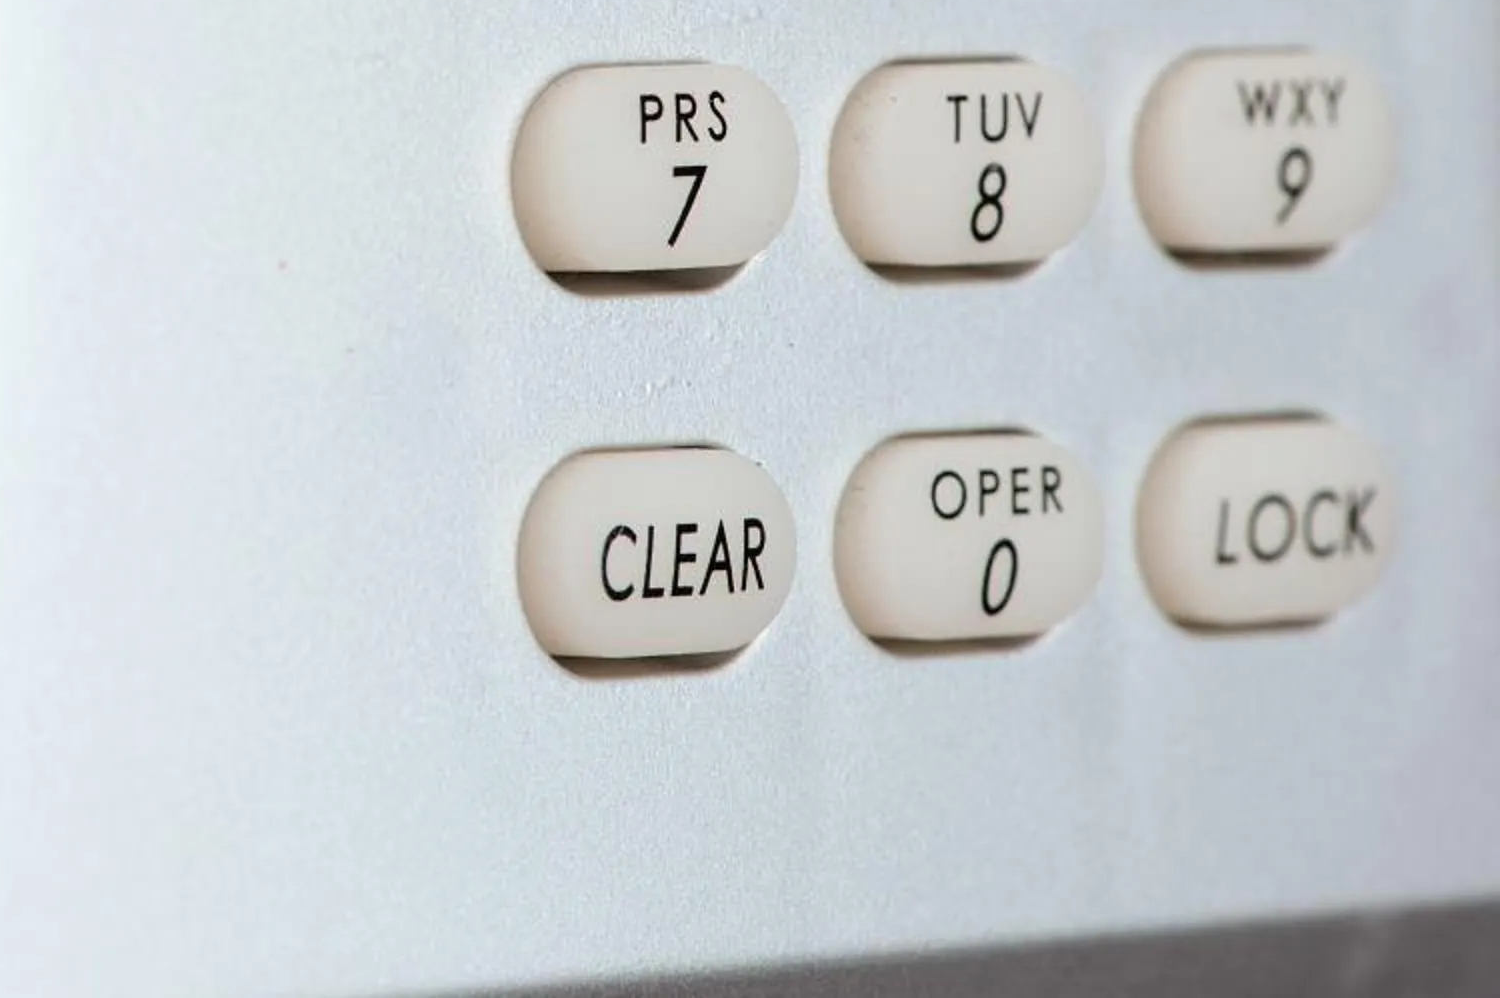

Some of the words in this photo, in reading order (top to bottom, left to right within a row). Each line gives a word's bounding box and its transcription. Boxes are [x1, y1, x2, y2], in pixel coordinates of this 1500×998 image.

[638, 89, 730, 145] PRS
[945, 92, 1045, 145] TUV
[1235, 77, 1348, 128] WXY
[665, 163, 710, 249] 7
[968, 162, 1009, 245] 8
[1274, 146, 1314, 228] 9
[929, 464, 1066, 521] OPER
[1213, 488, 1380, 568] LOCK
[599, 516, 768, 604] CLEAR
[979, 536, 1020, 619] 0
